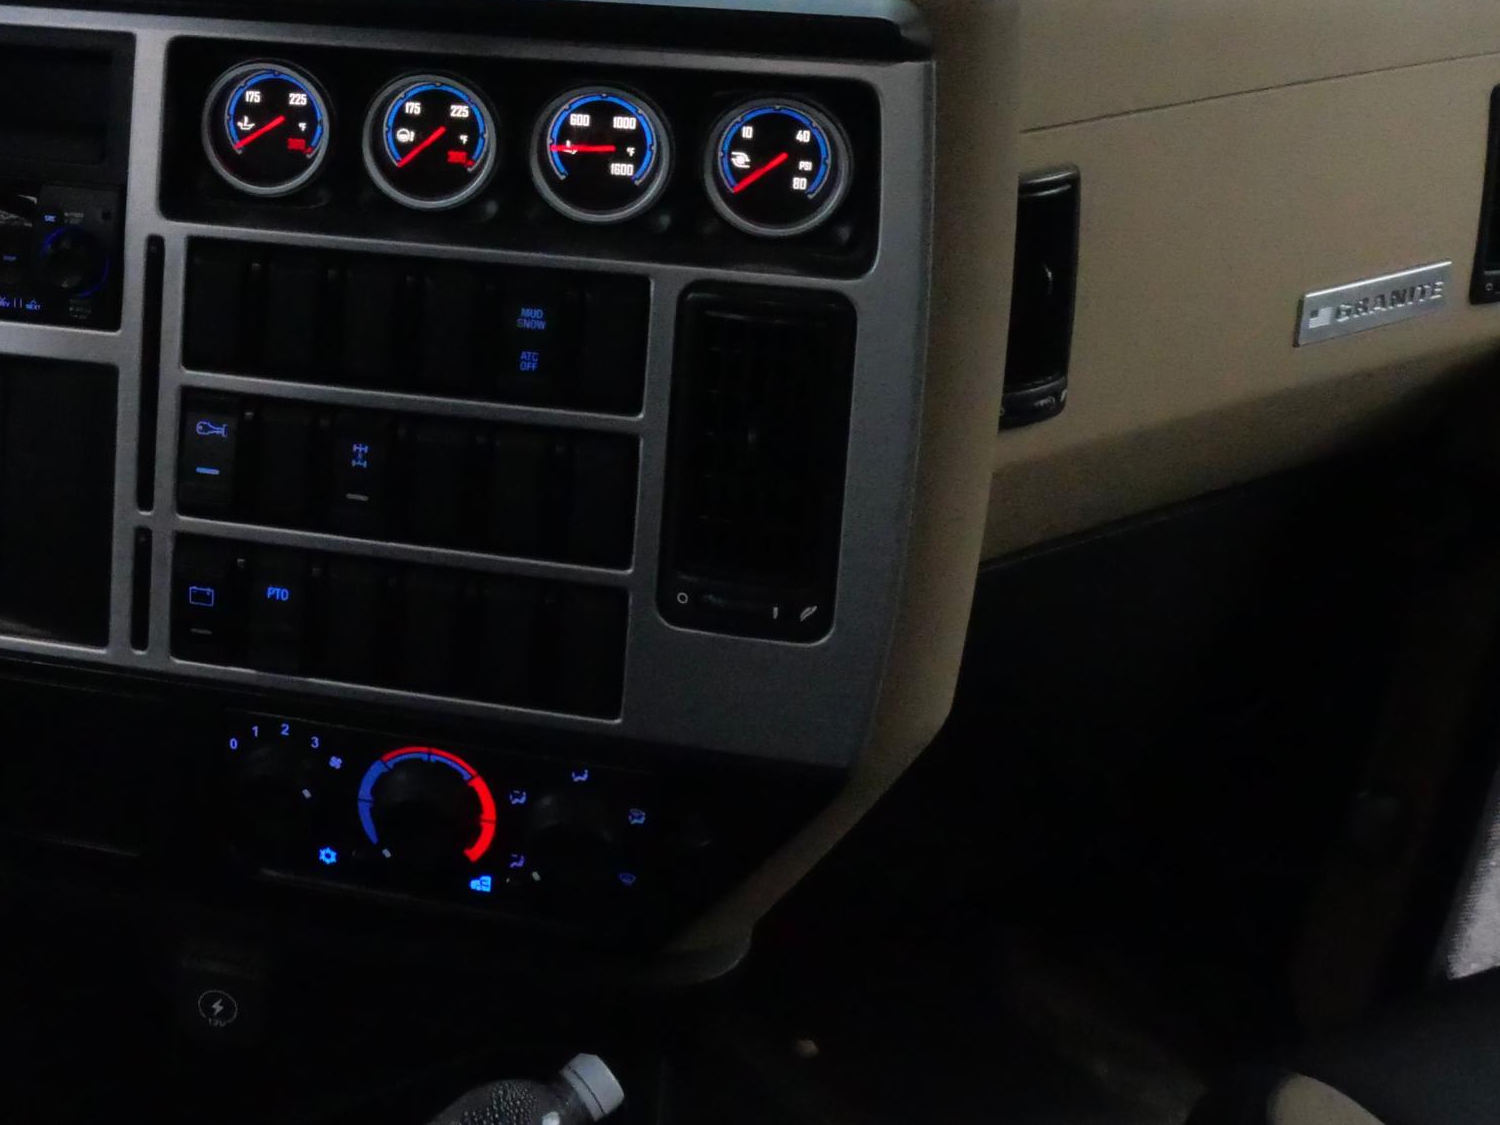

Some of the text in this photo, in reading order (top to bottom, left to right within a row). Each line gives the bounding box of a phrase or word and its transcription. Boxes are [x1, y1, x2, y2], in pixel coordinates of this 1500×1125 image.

[245, 91, 261, 103] 175
[289, 93, 307, 106] 225
[405, 102, 421, 114] 175
[450, 104, 469, 118] 225
[570, 114, 590, 127] 600
[613, 117, 636, 130] 1000
[741, 126, 753, 139] 10
[796, 130, 811, 143] 40
[521, 307, 544, 319] MUD
[516, 317, 546, 330] SNOW
[519, 361, 539, 372] OFF
[267, 586, 289, 601] PTO
[252, 725, 259, 737] 1
[280, 723, 290, 736] 2
[229, 737, 238, 750] 0
[310, 736, 320, 749] 3
